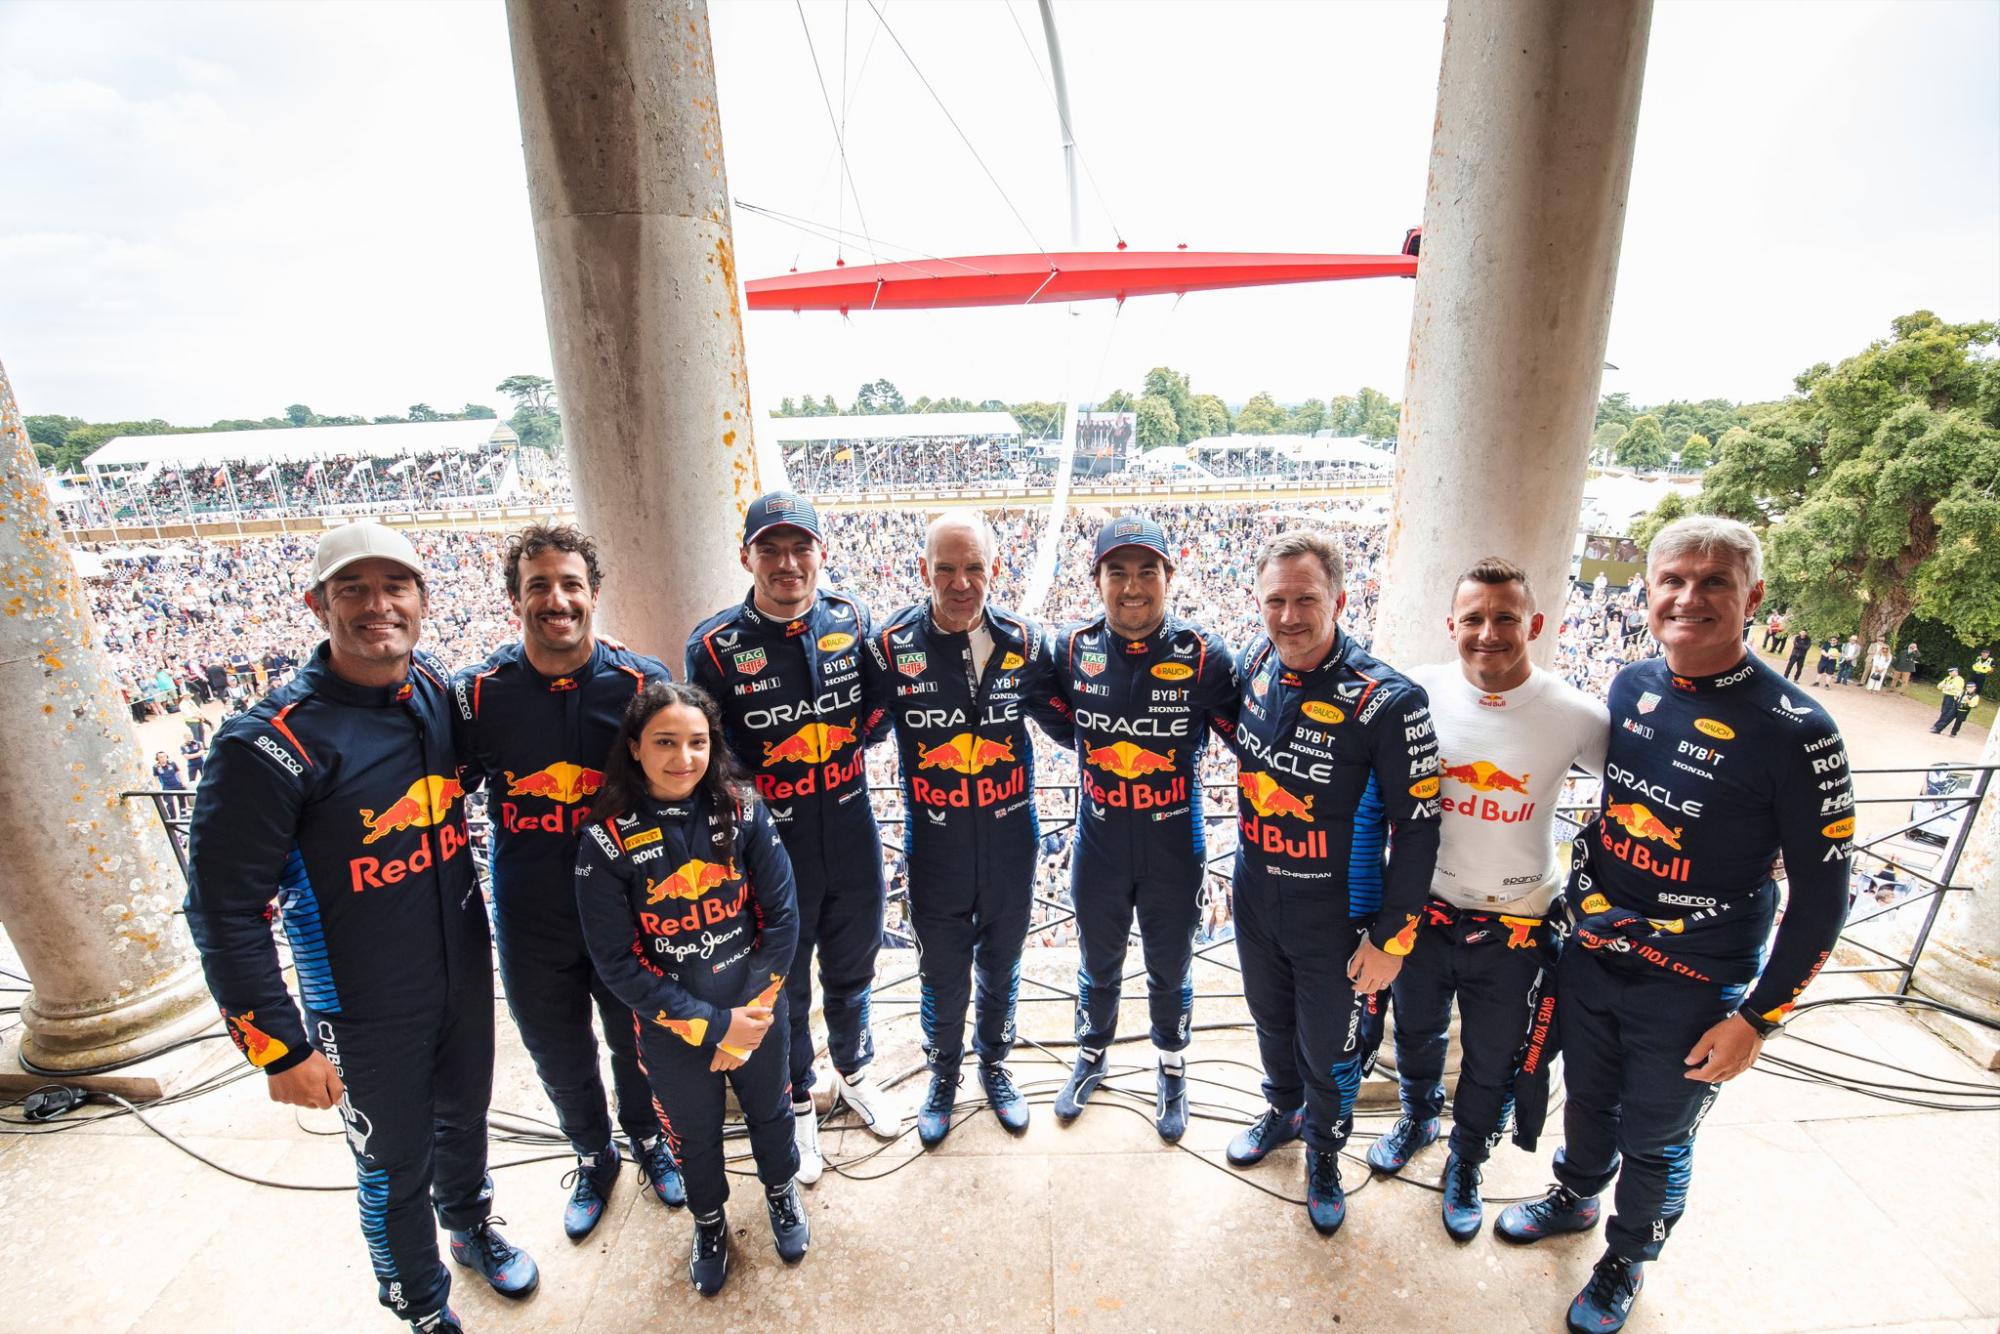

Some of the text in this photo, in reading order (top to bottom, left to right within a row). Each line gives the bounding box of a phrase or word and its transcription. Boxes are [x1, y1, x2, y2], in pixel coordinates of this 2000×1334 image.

[736, 650, 763, 662] TAG
[736, 659, 766, 674] HEUER
[823, 655, 857, 674] BYBIT
[900, 653, 924, 663] TAG
[1084, 652, 1105, 663] TAG
[899, 661, 926, 675] HEUER
[1162, 667, 1188, 676] RAUCH
[1715, 664, 1755, 688] zoom
[734, 680, 768, 696] Mobil
[824, 671, 860, 687] HONDA
[897, 682, 925, 697] Mobil
[1073, 680, 1099, 695] Mobil
[455, 679, 472, 721] sparco
[1151, 687, 1190, 702] BYBIT
[744, 683, 862, 729] ORACLE
[905, 702, 1019, 729] ORALE
[1148, 705, 1191, 713] HONDA
[1312, 706, 1340, 721] RAUCH
[1358, 687, 1392, 725] sparco
[1771, 706, 1804, 724] CASTORE
[1075, 708, 1189, 737] ORACLE
[1622, 717, 1643, 736] Mobil
[1703, 722, 1731, 737] RAUCH
[1295, 726, 1336, 748] BYBIT
[254, 736, 303, 777] sparco
[1236, 722, 1334, 784] ORACLE
[1288, 742, 1335, 761] HONDA
[1677, 740, 1725, 766] BYBIT
[755, 746, 864, 800] Red Bull
[1671, 759, 1715, 780] HONDA
[1812, 750, 1848, 775] ROK
[911, 766, 1025, 808] Red Bull
[1082, 768, 1186, 810] Red Bull
[1606, 762, 1705, 818] ORACLE
[500, 802, 564, 834] Red
[1164, 806, 1190, 819] CHECO
[1441, 794, 1536, 823] ed Bull
[588, 823, 620, 861] sparco
[1238, 812, 1328, 859] ed Bull
[350, 822, 469, 893] Red Bu
[632, 845, 664, 865] ROKT
[1631, 841, 1692, 882] Bull
[1281, 869, 1332, 879] CHRISTIAN
[1502, 873, 1543, 886] sparco
[640, 904, 701, 936] Red
[702, 882, 749, 926] Bull
[1657, 891, 1717, 908] sparco
[655, 937, 701, 963] Pepe
[700, 926, 743, 960] Jean
[1637, 946, 1670, 967] YOU
[1522, 996, 1556, 1075] GIVES YOU WINGS
